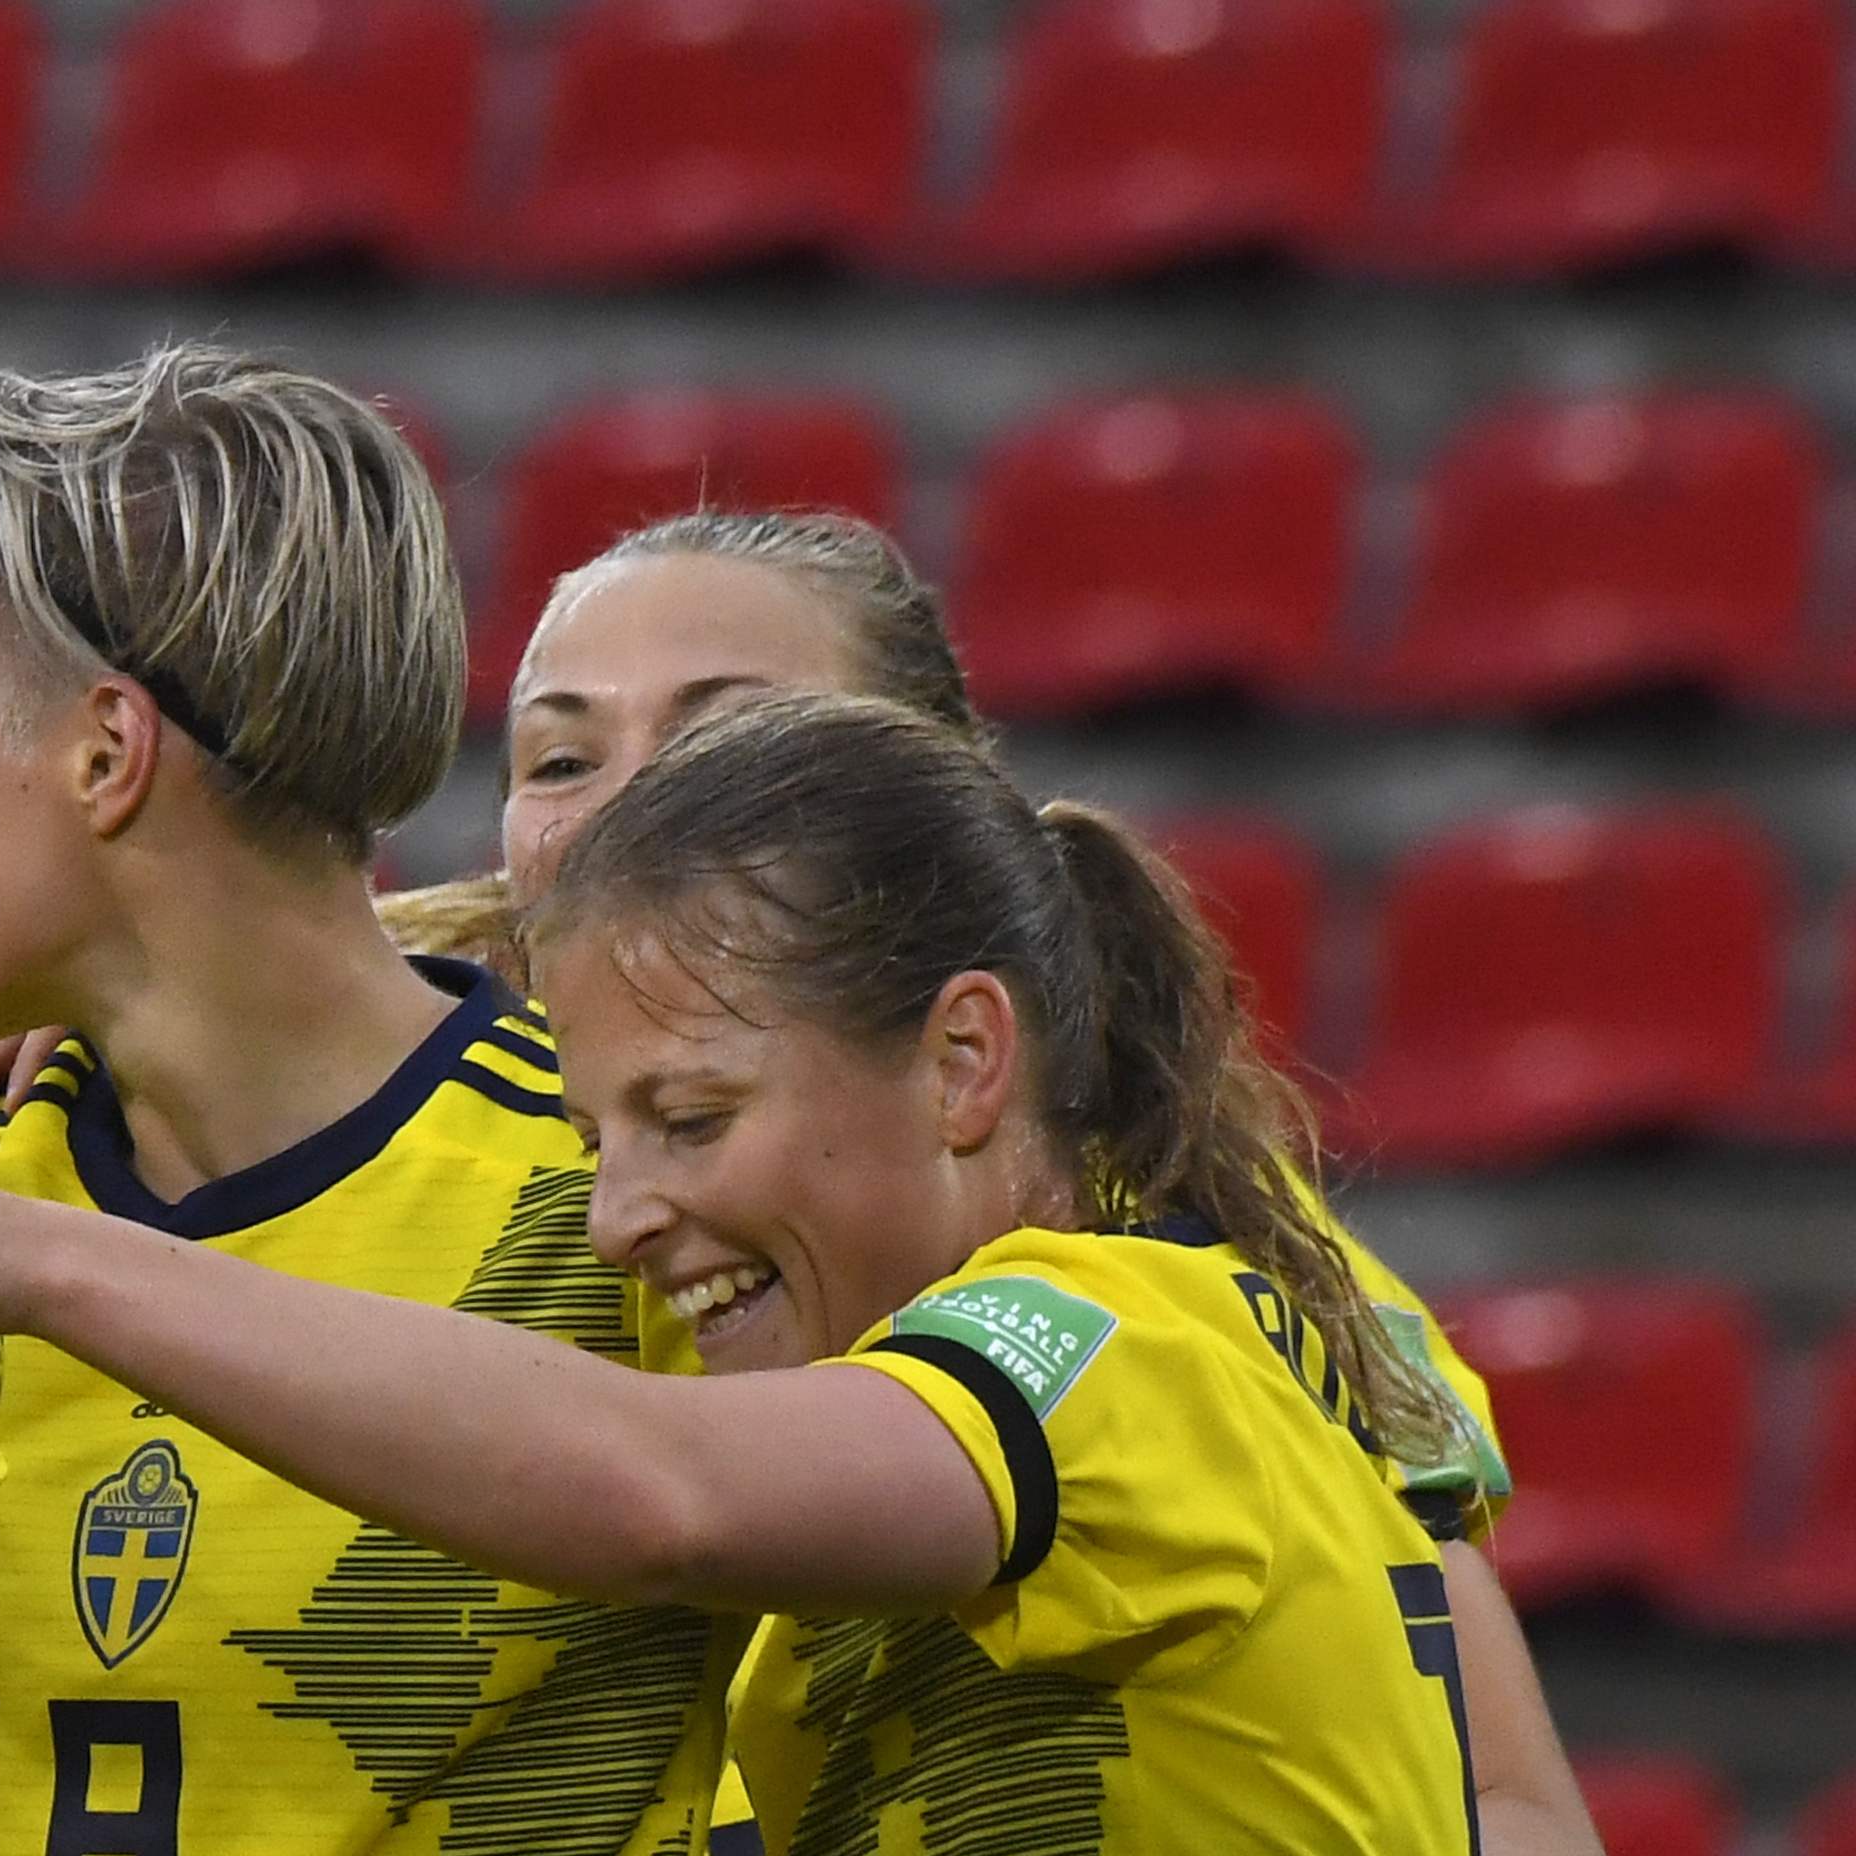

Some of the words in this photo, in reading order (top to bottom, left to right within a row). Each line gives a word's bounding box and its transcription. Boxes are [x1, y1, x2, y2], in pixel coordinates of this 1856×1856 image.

[957, 1292, 1079, 1352] IVING
[987, 1338, 1050, 1396] FIFA
[102, 1508, 177, 1526] SVERIGE
